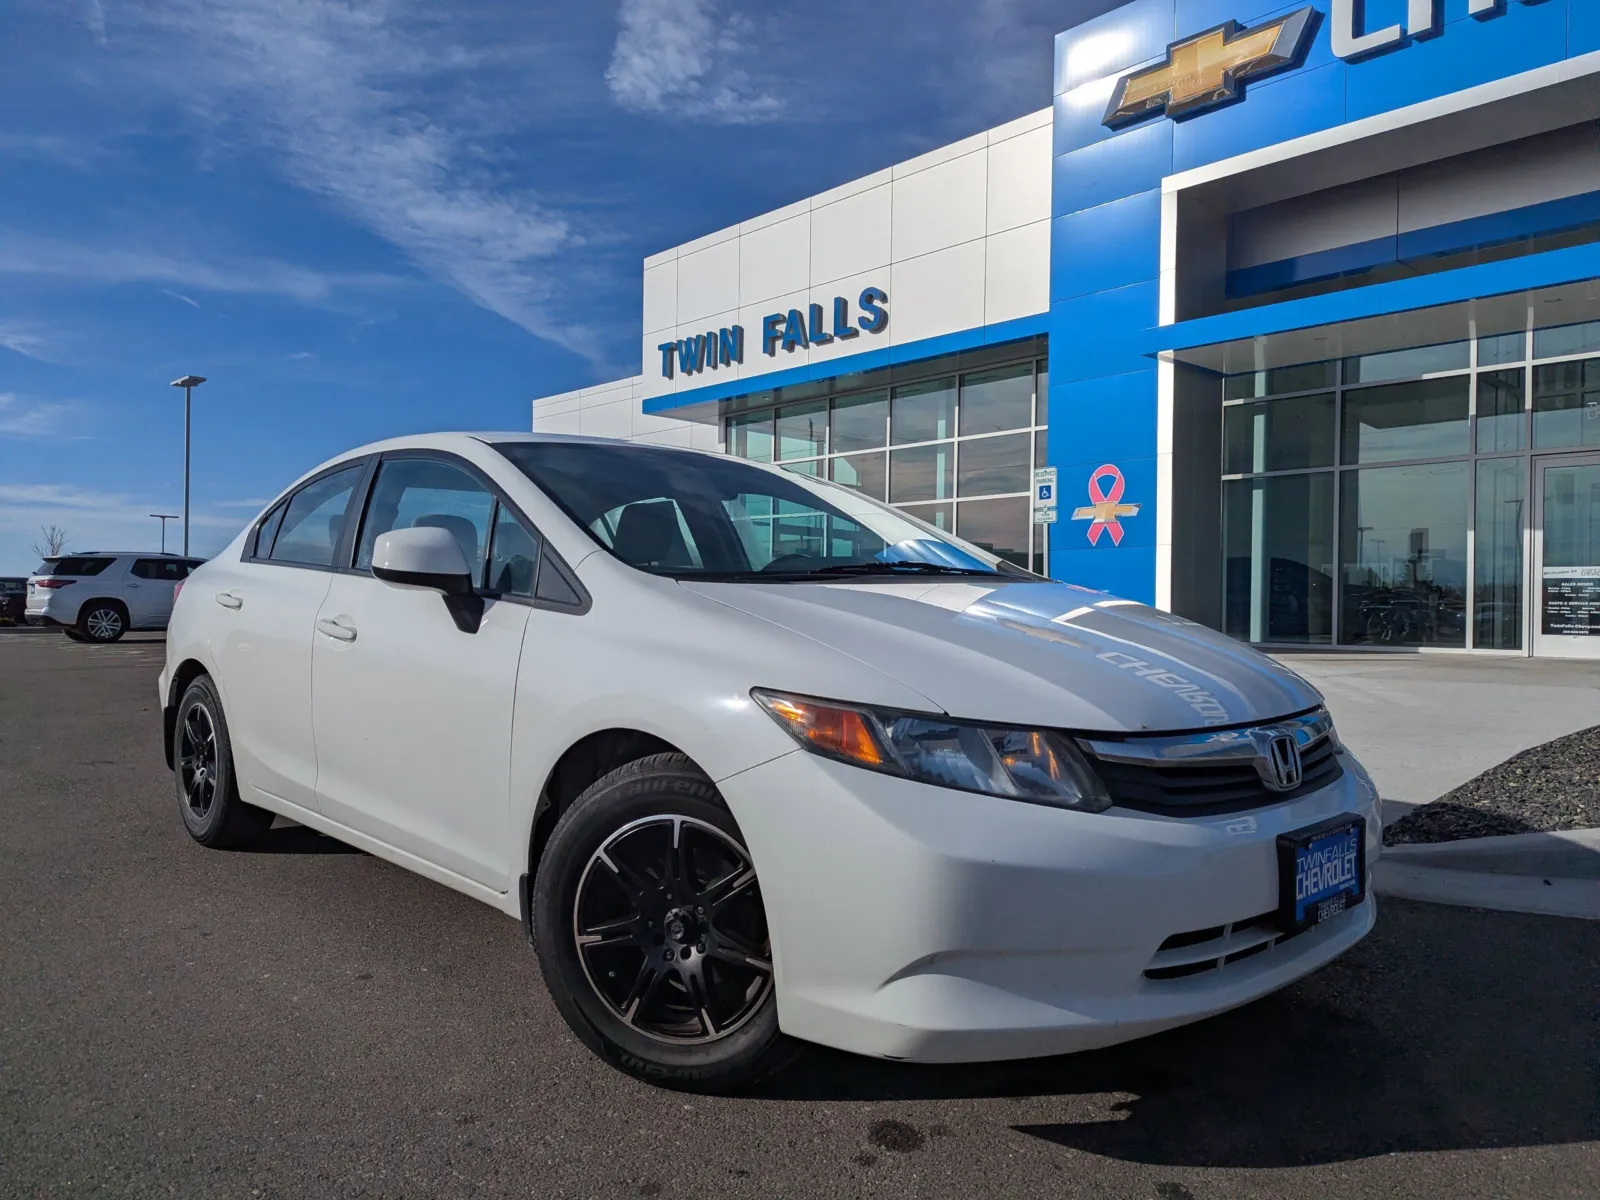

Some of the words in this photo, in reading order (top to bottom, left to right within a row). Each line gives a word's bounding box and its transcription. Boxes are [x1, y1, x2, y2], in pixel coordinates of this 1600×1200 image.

[658, 324, 744, 380] TWIN
[763, 286, 889, 358] FALLS
[1295, 852, 1357, 901] CHEVROLET
